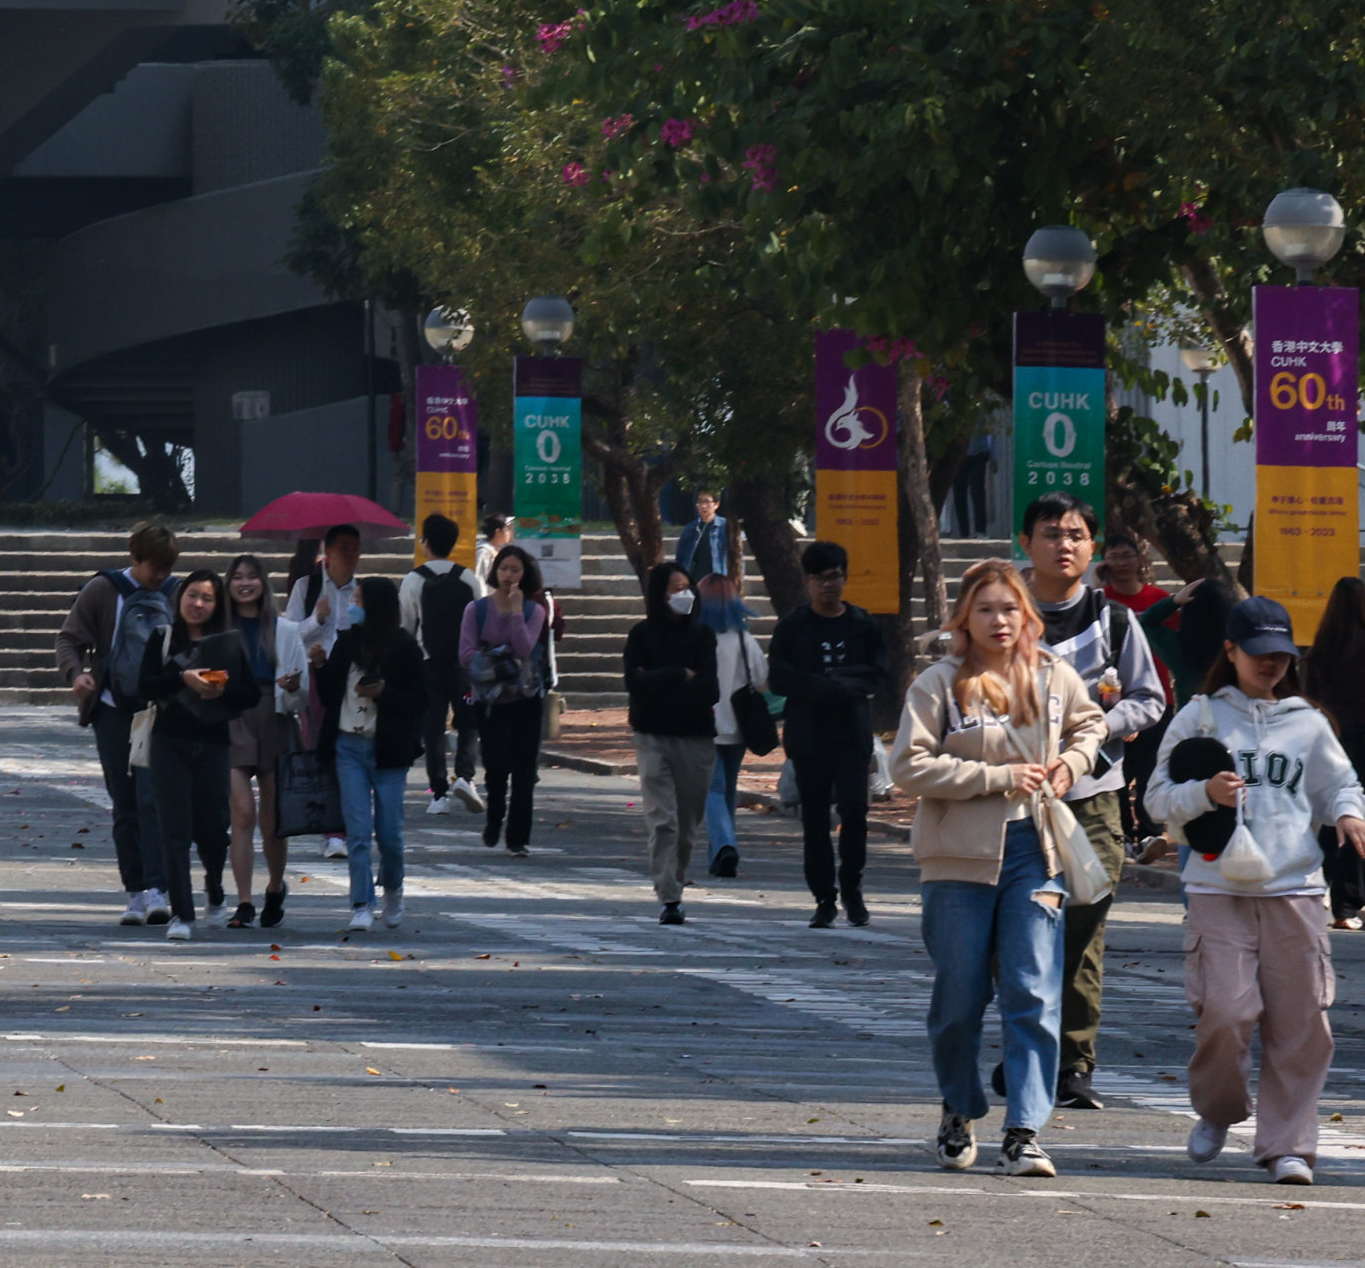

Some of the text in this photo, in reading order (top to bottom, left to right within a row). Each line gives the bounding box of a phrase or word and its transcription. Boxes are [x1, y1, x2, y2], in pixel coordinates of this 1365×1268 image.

[1271, 340, 1343, 354] 香港中文大學
[1270, 356, 1307, 367] CUHK
[1270, 372, 1345, 411] 60th
[1029, 392, 1090, 410] CUHK
[525, 415, 570, 428] CUHK
